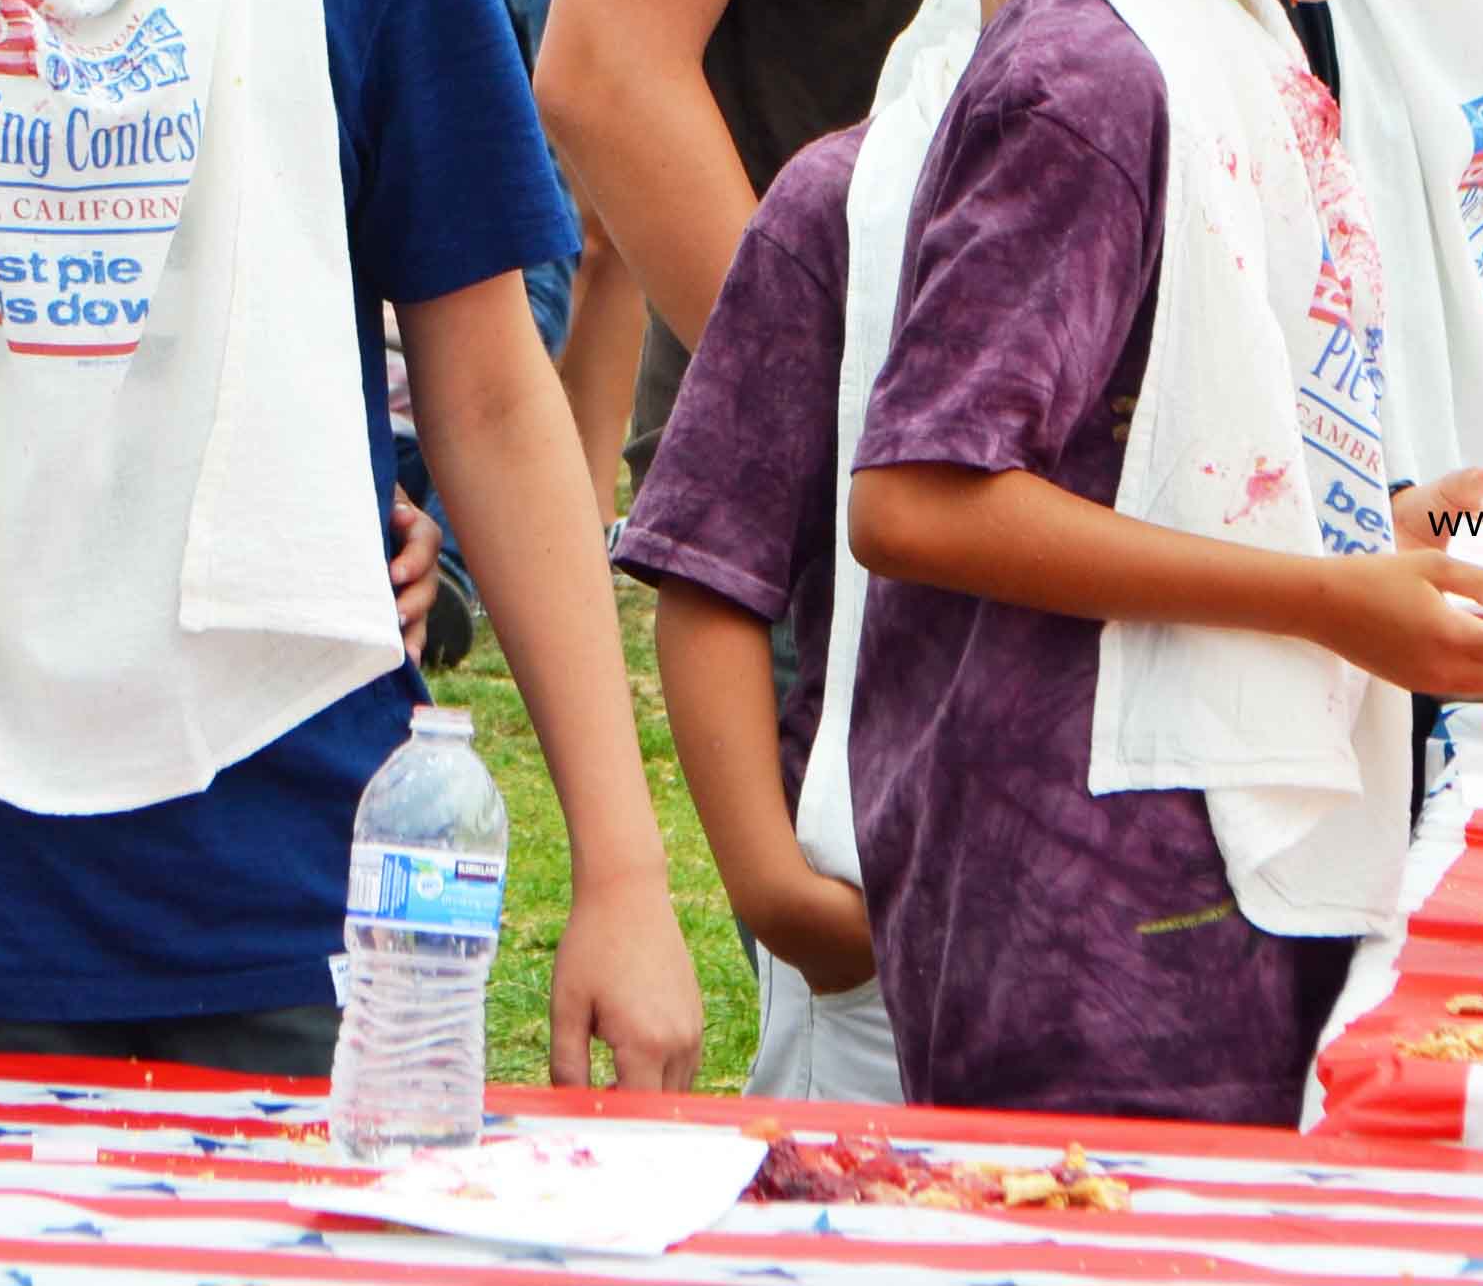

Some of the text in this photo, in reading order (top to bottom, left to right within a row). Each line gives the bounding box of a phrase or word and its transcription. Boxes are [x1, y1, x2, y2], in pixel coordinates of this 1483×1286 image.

[66, 98, 204, 172] Contest
[13, 195, 181, 223] CALIFORN
[56, 250, 143, 292] pie
[47, 292, 150, 327] dow
[1296, 402, 1380, 474] CAMBR
